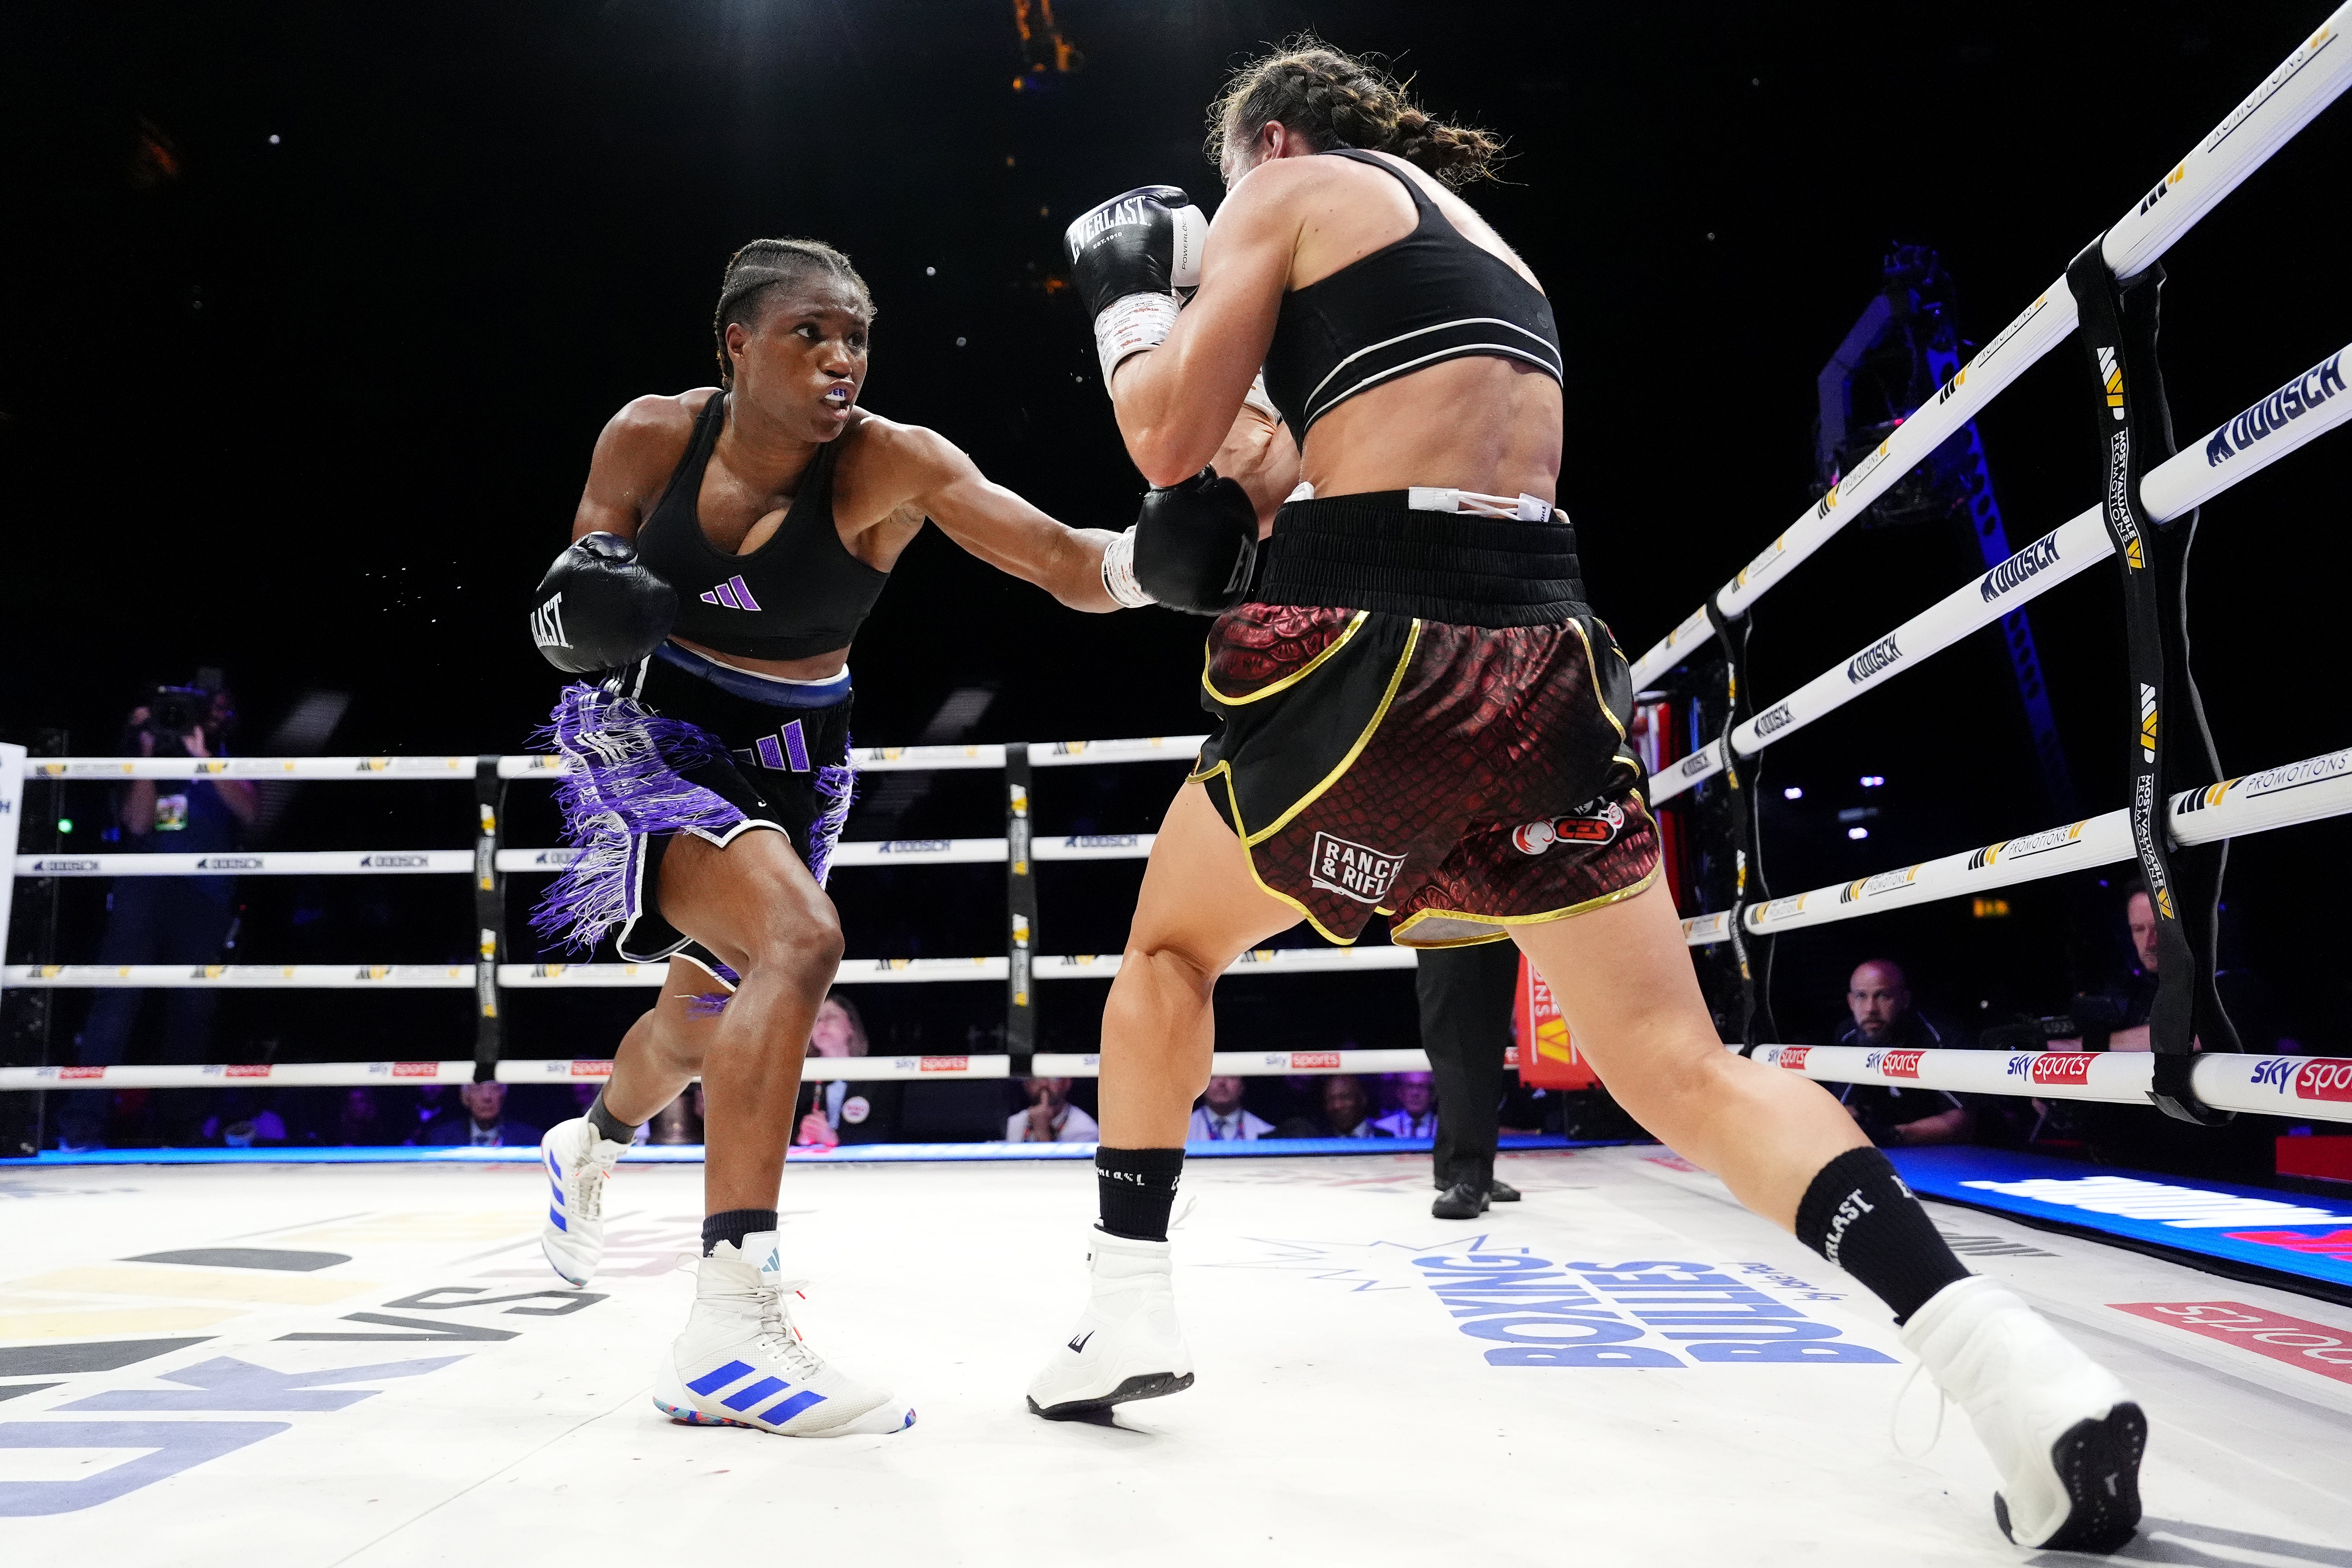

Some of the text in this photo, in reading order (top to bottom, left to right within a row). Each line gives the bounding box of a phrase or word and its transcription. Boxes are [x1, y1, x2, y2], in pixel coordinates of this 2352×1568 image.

[1069, 195, 1148, 265] EVERLAST
[1093, 232, 1122, 249] EST.1910
[1120, 338, 1142, 347] empi
[2111, 433, 2129, 542] PROMOTIONS
[2117, 470, 2137, 539] VALUABLE
[2247, 754, 2348, 791] PROMOTIONS
[2009, 830, 2067, 855] PROMOTIONS
[2136, 775, 2158, 888] PROMOTIONS
[2142, 775, 2164, 887] MOST VALUABLE
[1322, 858, 1336, 878] &
[1325, 841, 1405, 879] RANCH
[1294, 1054, 1339, 1067] sports
[1781, 1048, 1808, 1067] sports
[1866, 1050, 1920, 1075] sky sports
[2007, 1053, 2090, 1081] sky sports
[2251, 1057, 2352, 1095] sky spo
[1758, 1275, 1820, 1290] Jake
[1793, 1291, 1848, 1300] by
[271, 1287, 610, 1341] VS
[1412, 1256, 1689, 1368] BOXING
[1565, 1261, 1904, 1364] BULLIES
[2153, 1306, 2352, 1364] orts
[0, 1354, 476, 1517] UK
